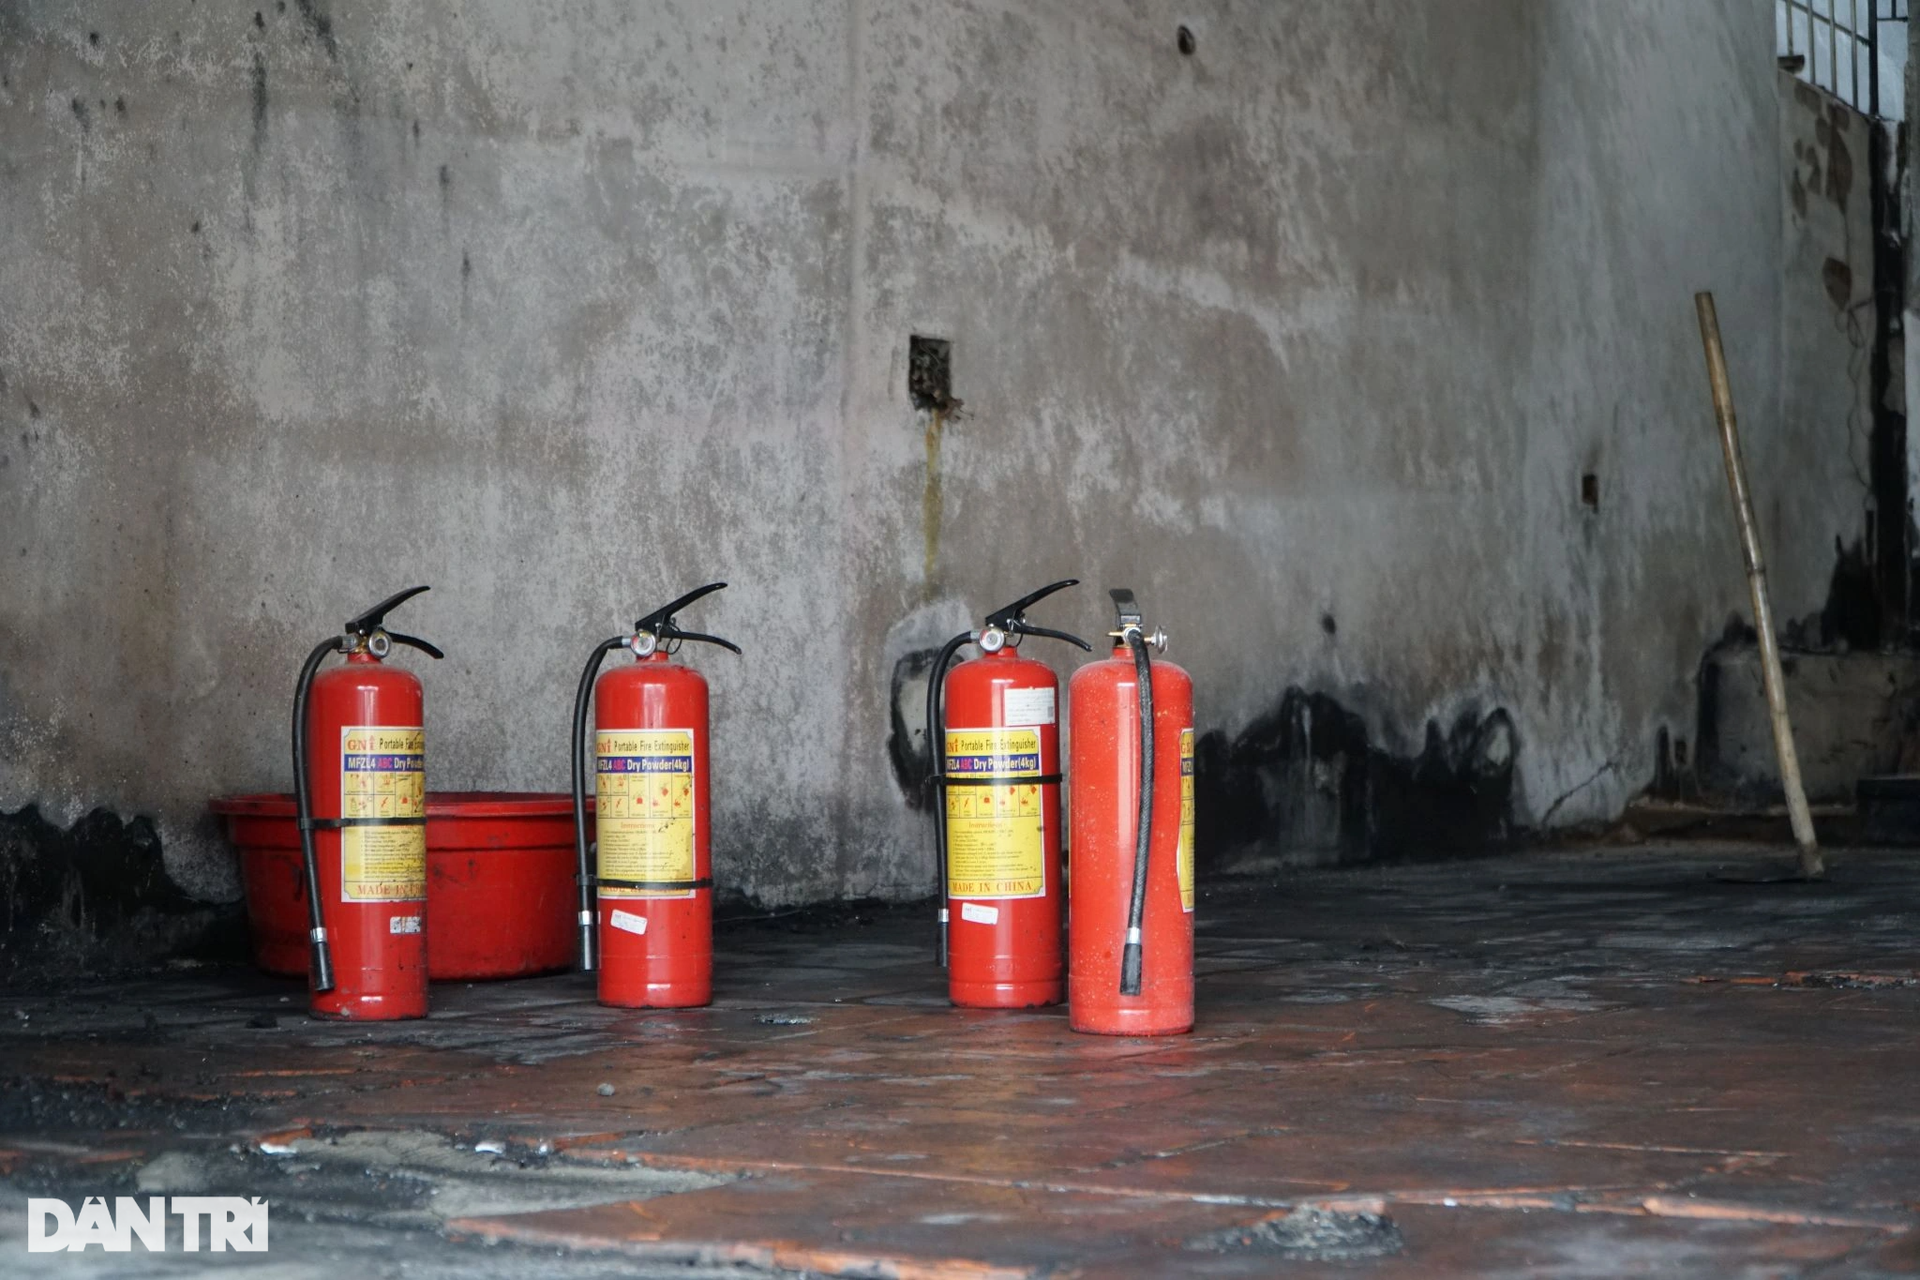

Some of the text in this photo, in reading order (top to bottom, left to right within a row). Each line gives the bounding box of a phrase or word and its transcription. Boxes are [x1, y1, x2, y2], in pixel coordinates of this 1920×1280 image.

[379, 738, 404, 750] Portable
[614, 740, 690, 754] Portable Fire Extinguisher
[961, 740, 984, 752] Portable
[1000, 738, 1036, 752] Extinguisher
[348, 757, 376, 769] MFZL4
[378, 757, 393, 769] ABC
[394, 757, 407, 770] Dry
[613, 759, 626, 770] ABC
[627, 759, 641, 772] Dry
[642, 759, 690, 773] Powder(4kg)
[960, 758, 973, 770] ABC
[974, 757, 987, 771] Dry
[988, 757, 1036, 771] Powder(4kg)
[357, 885, 391, 895] MADE
[952, 881, 1033, 893] MADE IN CHINA
